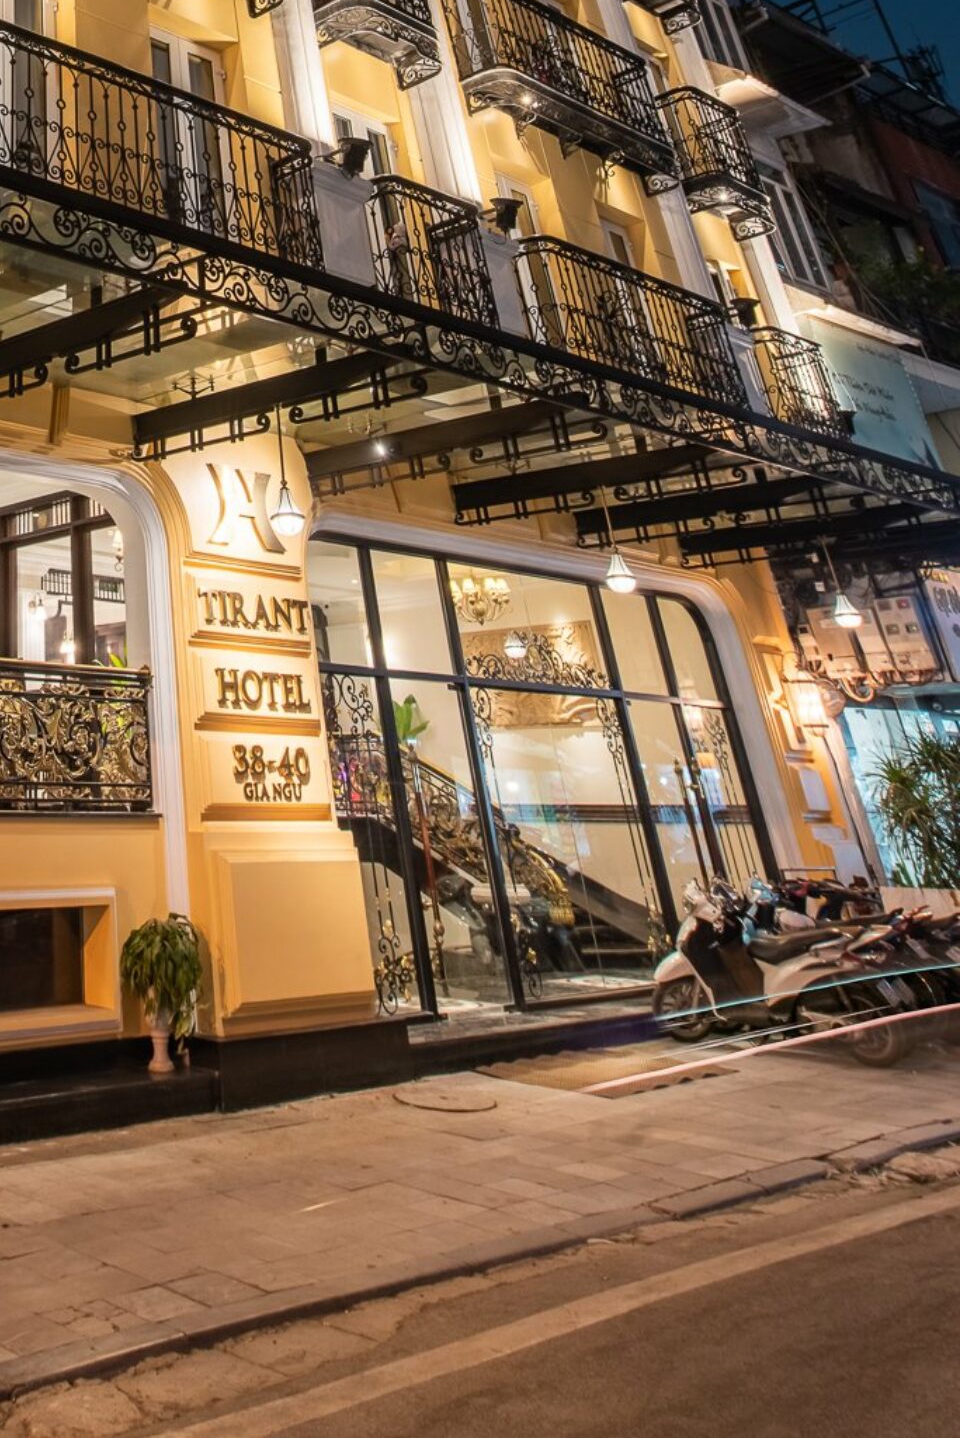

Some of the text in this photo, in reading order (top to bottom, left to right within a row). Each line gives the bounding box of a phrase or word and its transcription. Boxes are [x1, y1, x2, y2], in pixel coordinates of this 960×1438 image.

[198, 588, 309, 636] TIRANT
[215, 667, 311, 714] HOTEL
[232, 744, 311, 785] 38-40
[243, 782, 270, 803] GIA
